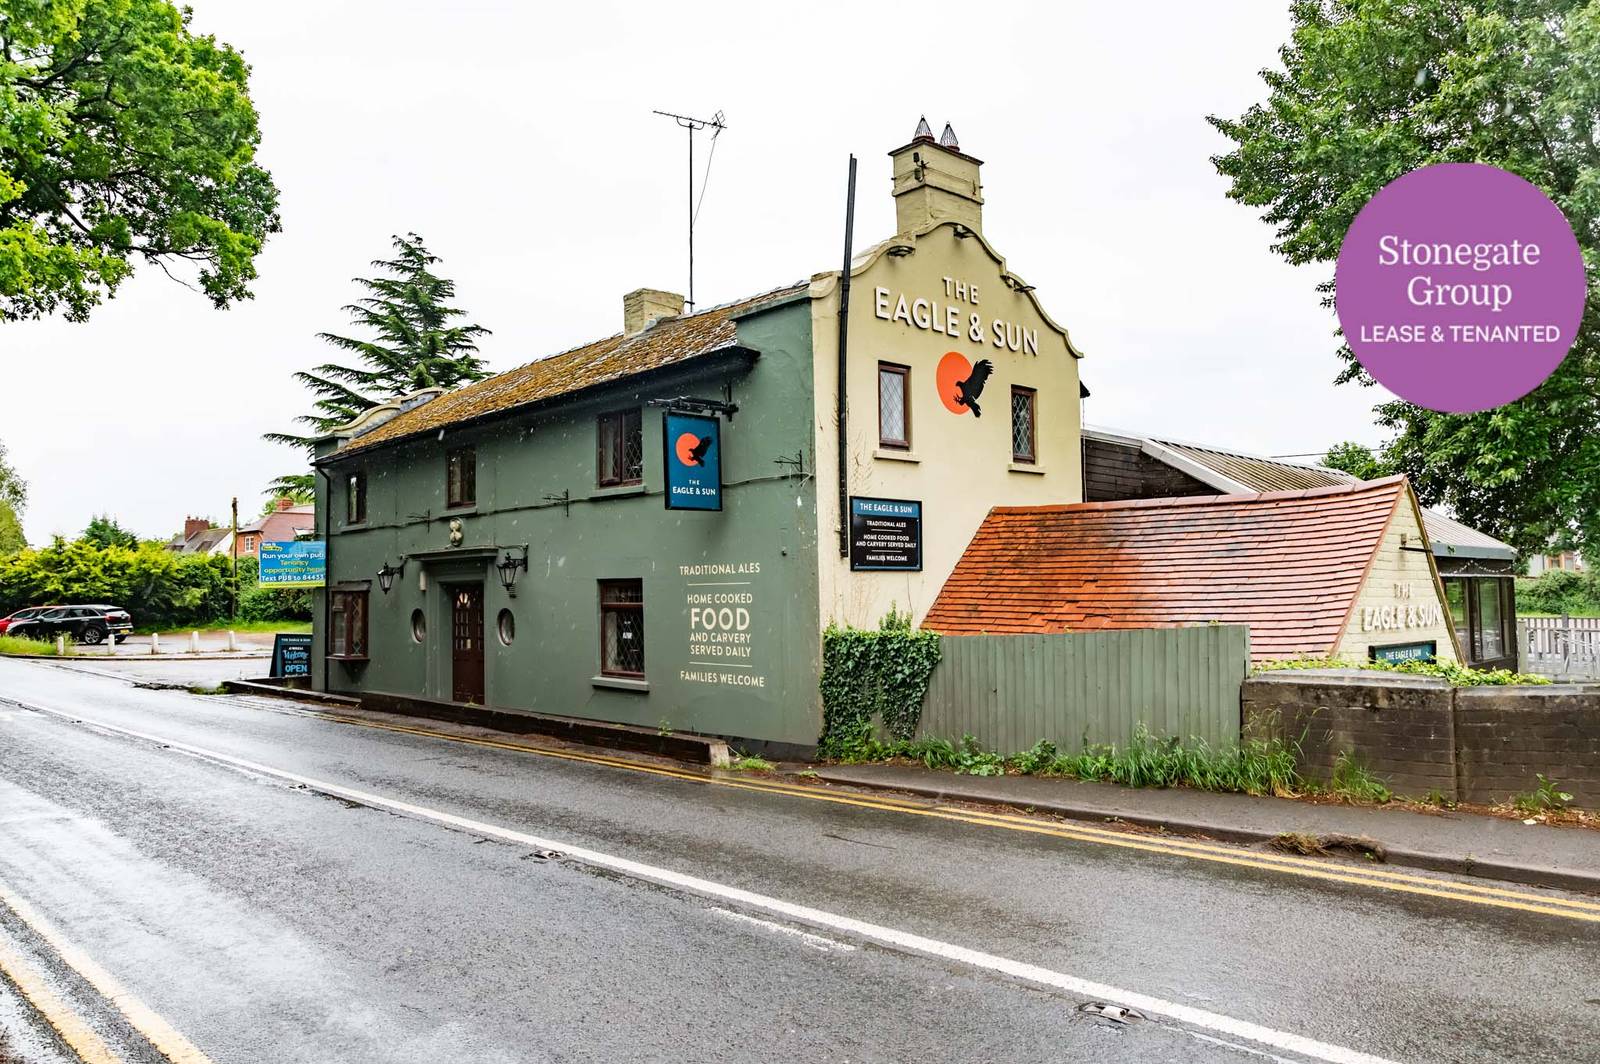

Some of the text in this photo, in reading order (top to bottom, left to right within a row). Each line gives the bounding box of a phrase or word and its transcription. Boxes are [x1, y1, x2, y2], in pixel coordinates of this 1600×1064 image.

[943, 276, 980, 305] THE
[875, 286, 1039, 356] EAGLE & SUN
[672, 486, 694, 494] EAGLE
[874, 504, 892, 512] EAGLE
[680, 562, 760, 576] TRADITIONAL ALES
[687, 594, 753, 604] HOME COOKED
[691, 608, 750, 630] FOOD
[1362, 602, 1440, 632] EAGLE & SUN
[690, 632, 751, 644] AND CARVERY
[690, 645, 751, 657] SERVED DAILY
[1395, 650, 1408, 659] EAGLE
[285, 664, 308, 672] OPEN
[680, 671, 765, 687] FAMILIES WELCOME
